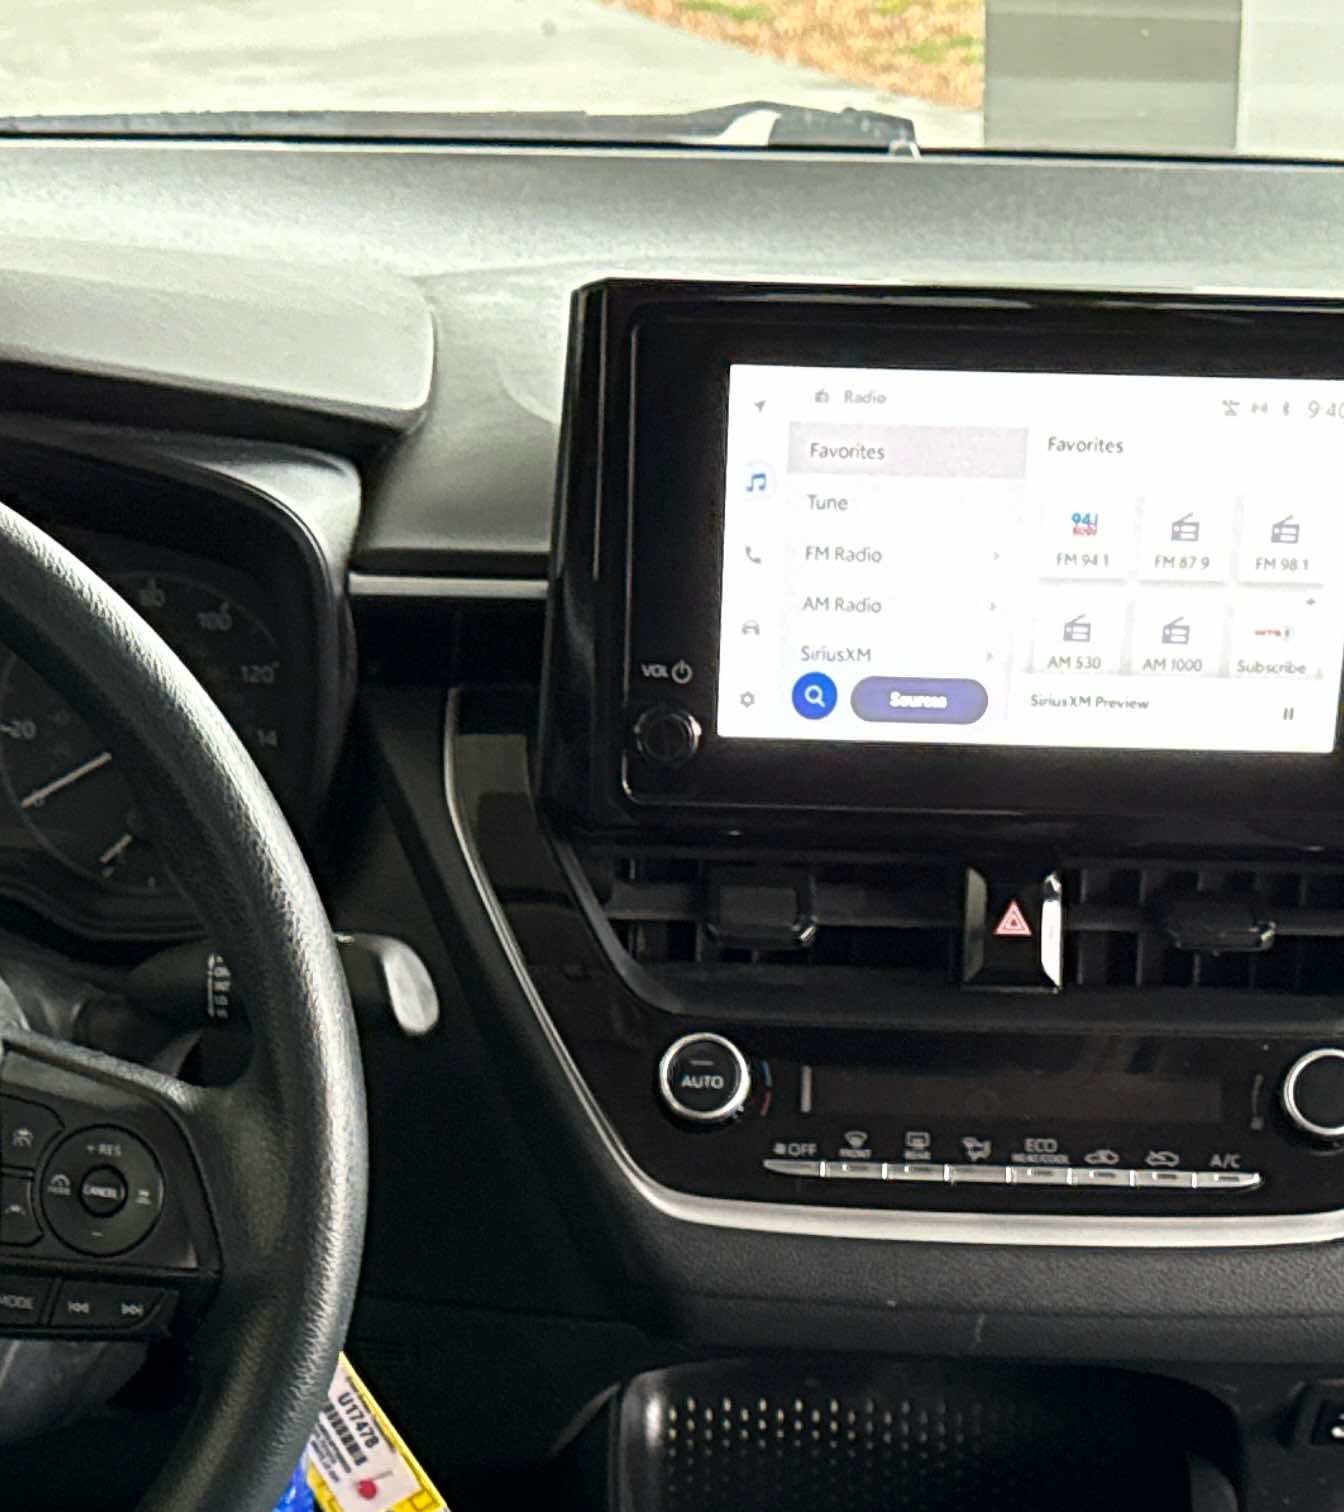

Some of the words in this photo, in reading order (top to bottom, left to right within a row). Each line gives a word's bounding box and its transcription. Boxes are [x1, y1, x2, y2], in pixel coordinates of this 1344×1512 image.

[844, 390, 887, 405] Radio
[810, 441, 885, 461] Favorites
[1047, 436, 1124, 453] Favorites
[808, 494, 849, 511] Tune
[805, 545, 830, 561] FM
[834, 546, 882, 563] Radio
[1056, 552, 1077, 566] FM
[1154, 555, 1175, 569] FM
[1255, 557, 1277, 570] FM
[802, 597, 830, 612] AM
[834, 597, 882, 613] Radio
[801, 645, 872, 662] SiriusXM
[640, 663, 669, 678] VOL
[1047, 656, 1073, 670] AM
[1075, 656, 1102, 670] 530
[1142, 658, 1167, 671] AM
[1171, 659, 1203, 672] 1000
[1236, 660, 1307, 675] Subscribe
[1030, 694, 1092, 709] SiriusXM
[1095, 696, 1150, 711] Preview
[681, 1075, 725, 1090] AUTO
[788, 1142, 817, 1158] OFF
[1024, 1138, 1058, 1153] ECO
[1209, 1151, 1241, 1168] A/C
